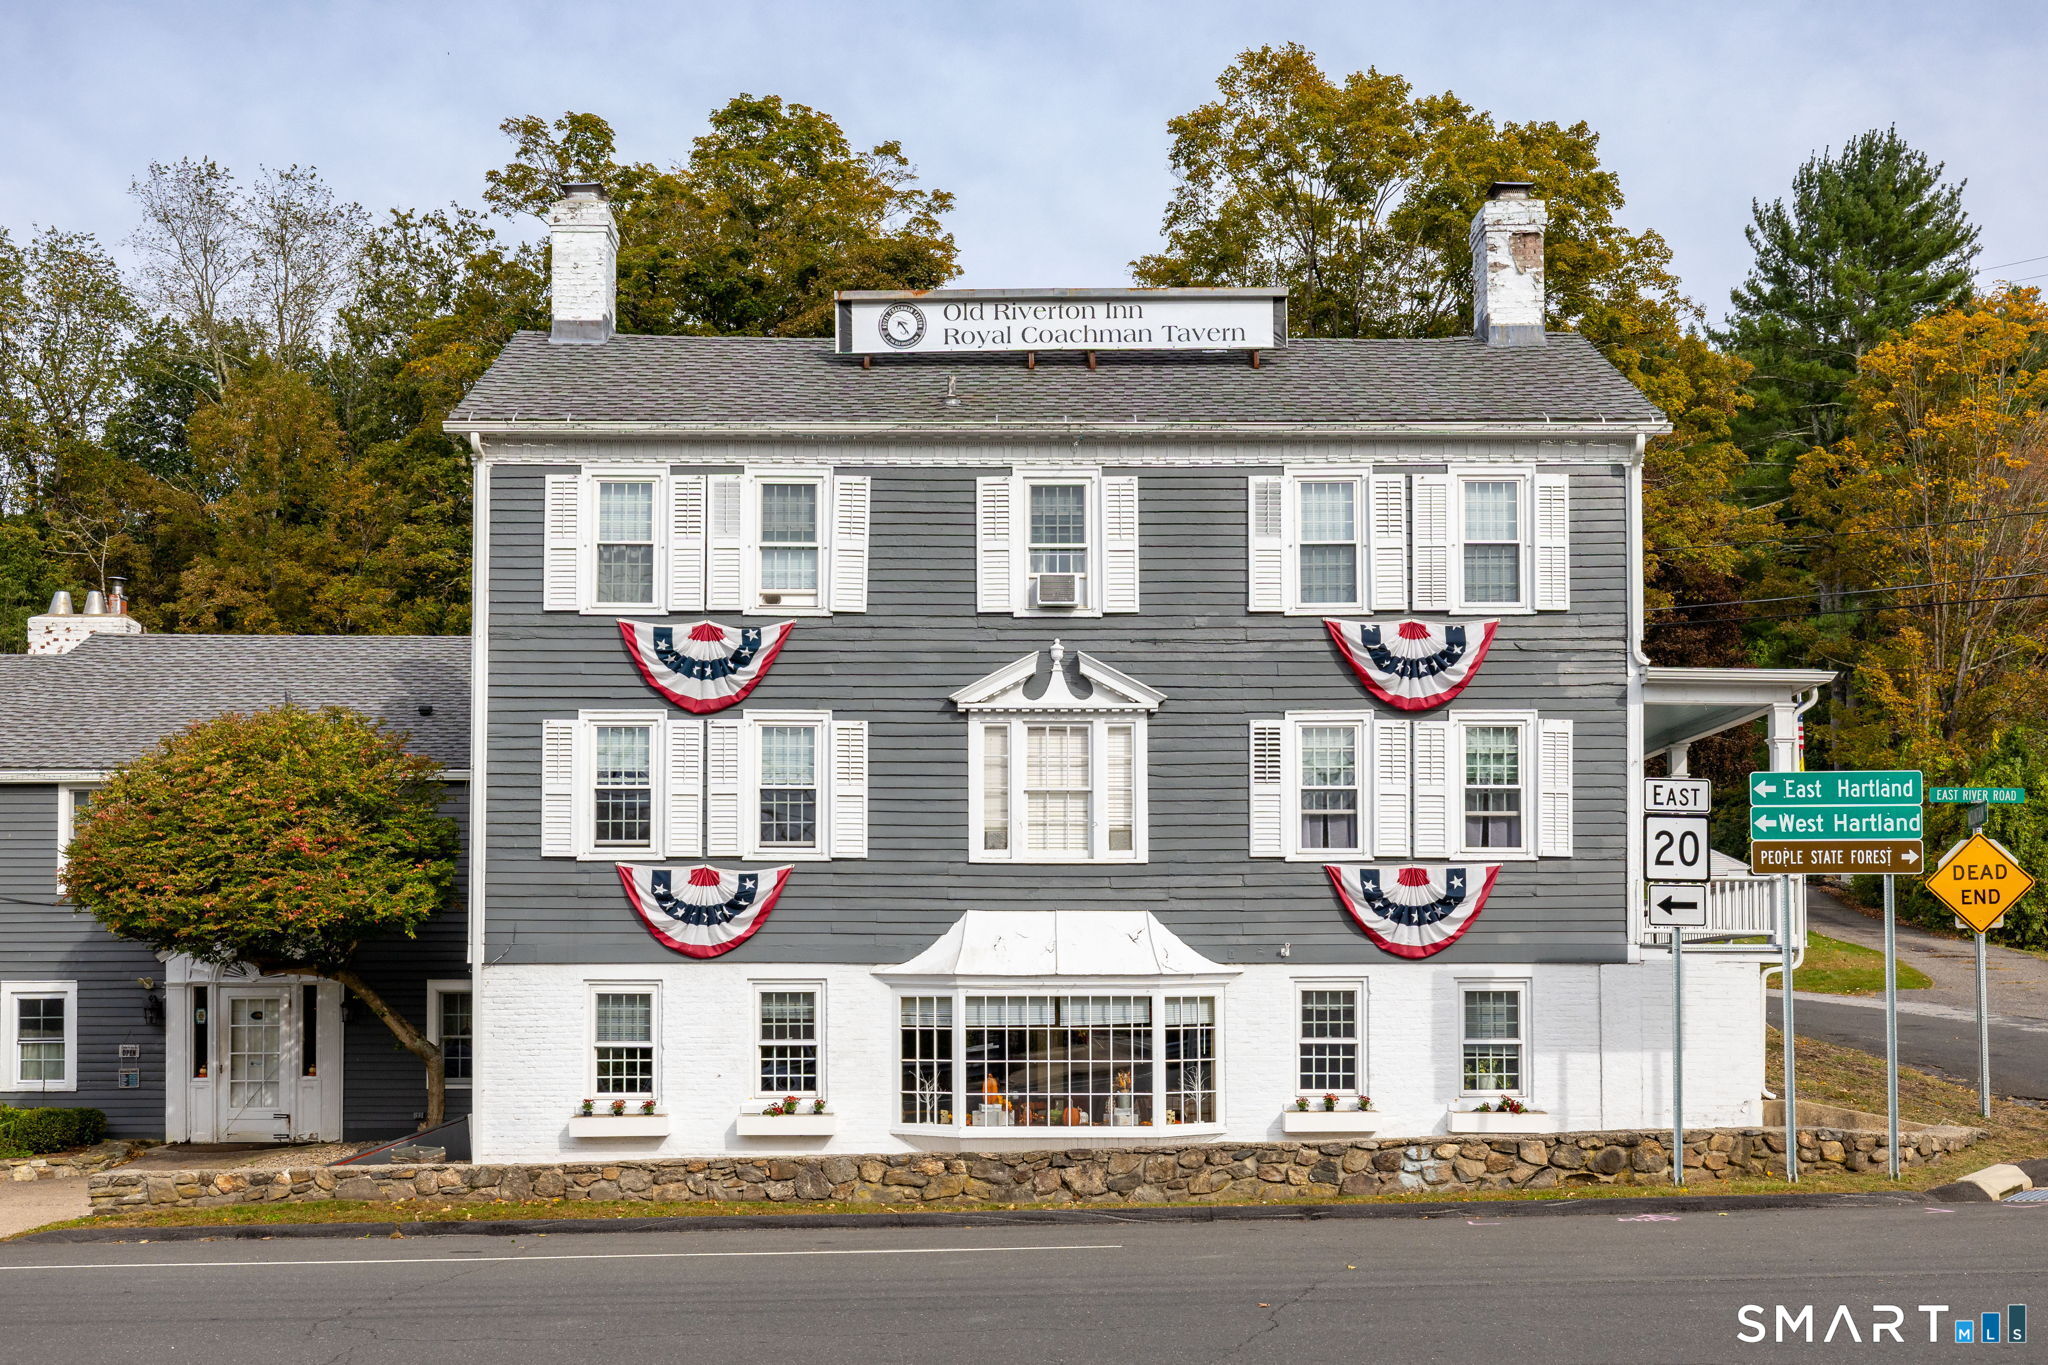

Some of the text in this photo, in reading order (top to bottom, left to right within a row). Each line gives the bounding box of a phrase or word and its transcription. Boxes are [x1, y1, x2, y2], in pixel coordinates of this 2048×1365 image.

[943, 302, 1143, 321] Old Riverton Inn
[943, 325, 1246, 349] Royal Coachman Tavern
[1653, 785, 1700, 806] EAST
[1784, 779, 1913, 798] East Hartland
[1936, 789, 2017, 801] EAST RIVER ROAD
[1778, 813, 1921, 833] West Hartland
[1655, 829, 1700, 867] 20
[1760, 849, 1892, 865] PEOPLE STATE FOREST
[1953, 864, 2007, 880] DEAD
[1961, 889, 2000, 905] END
